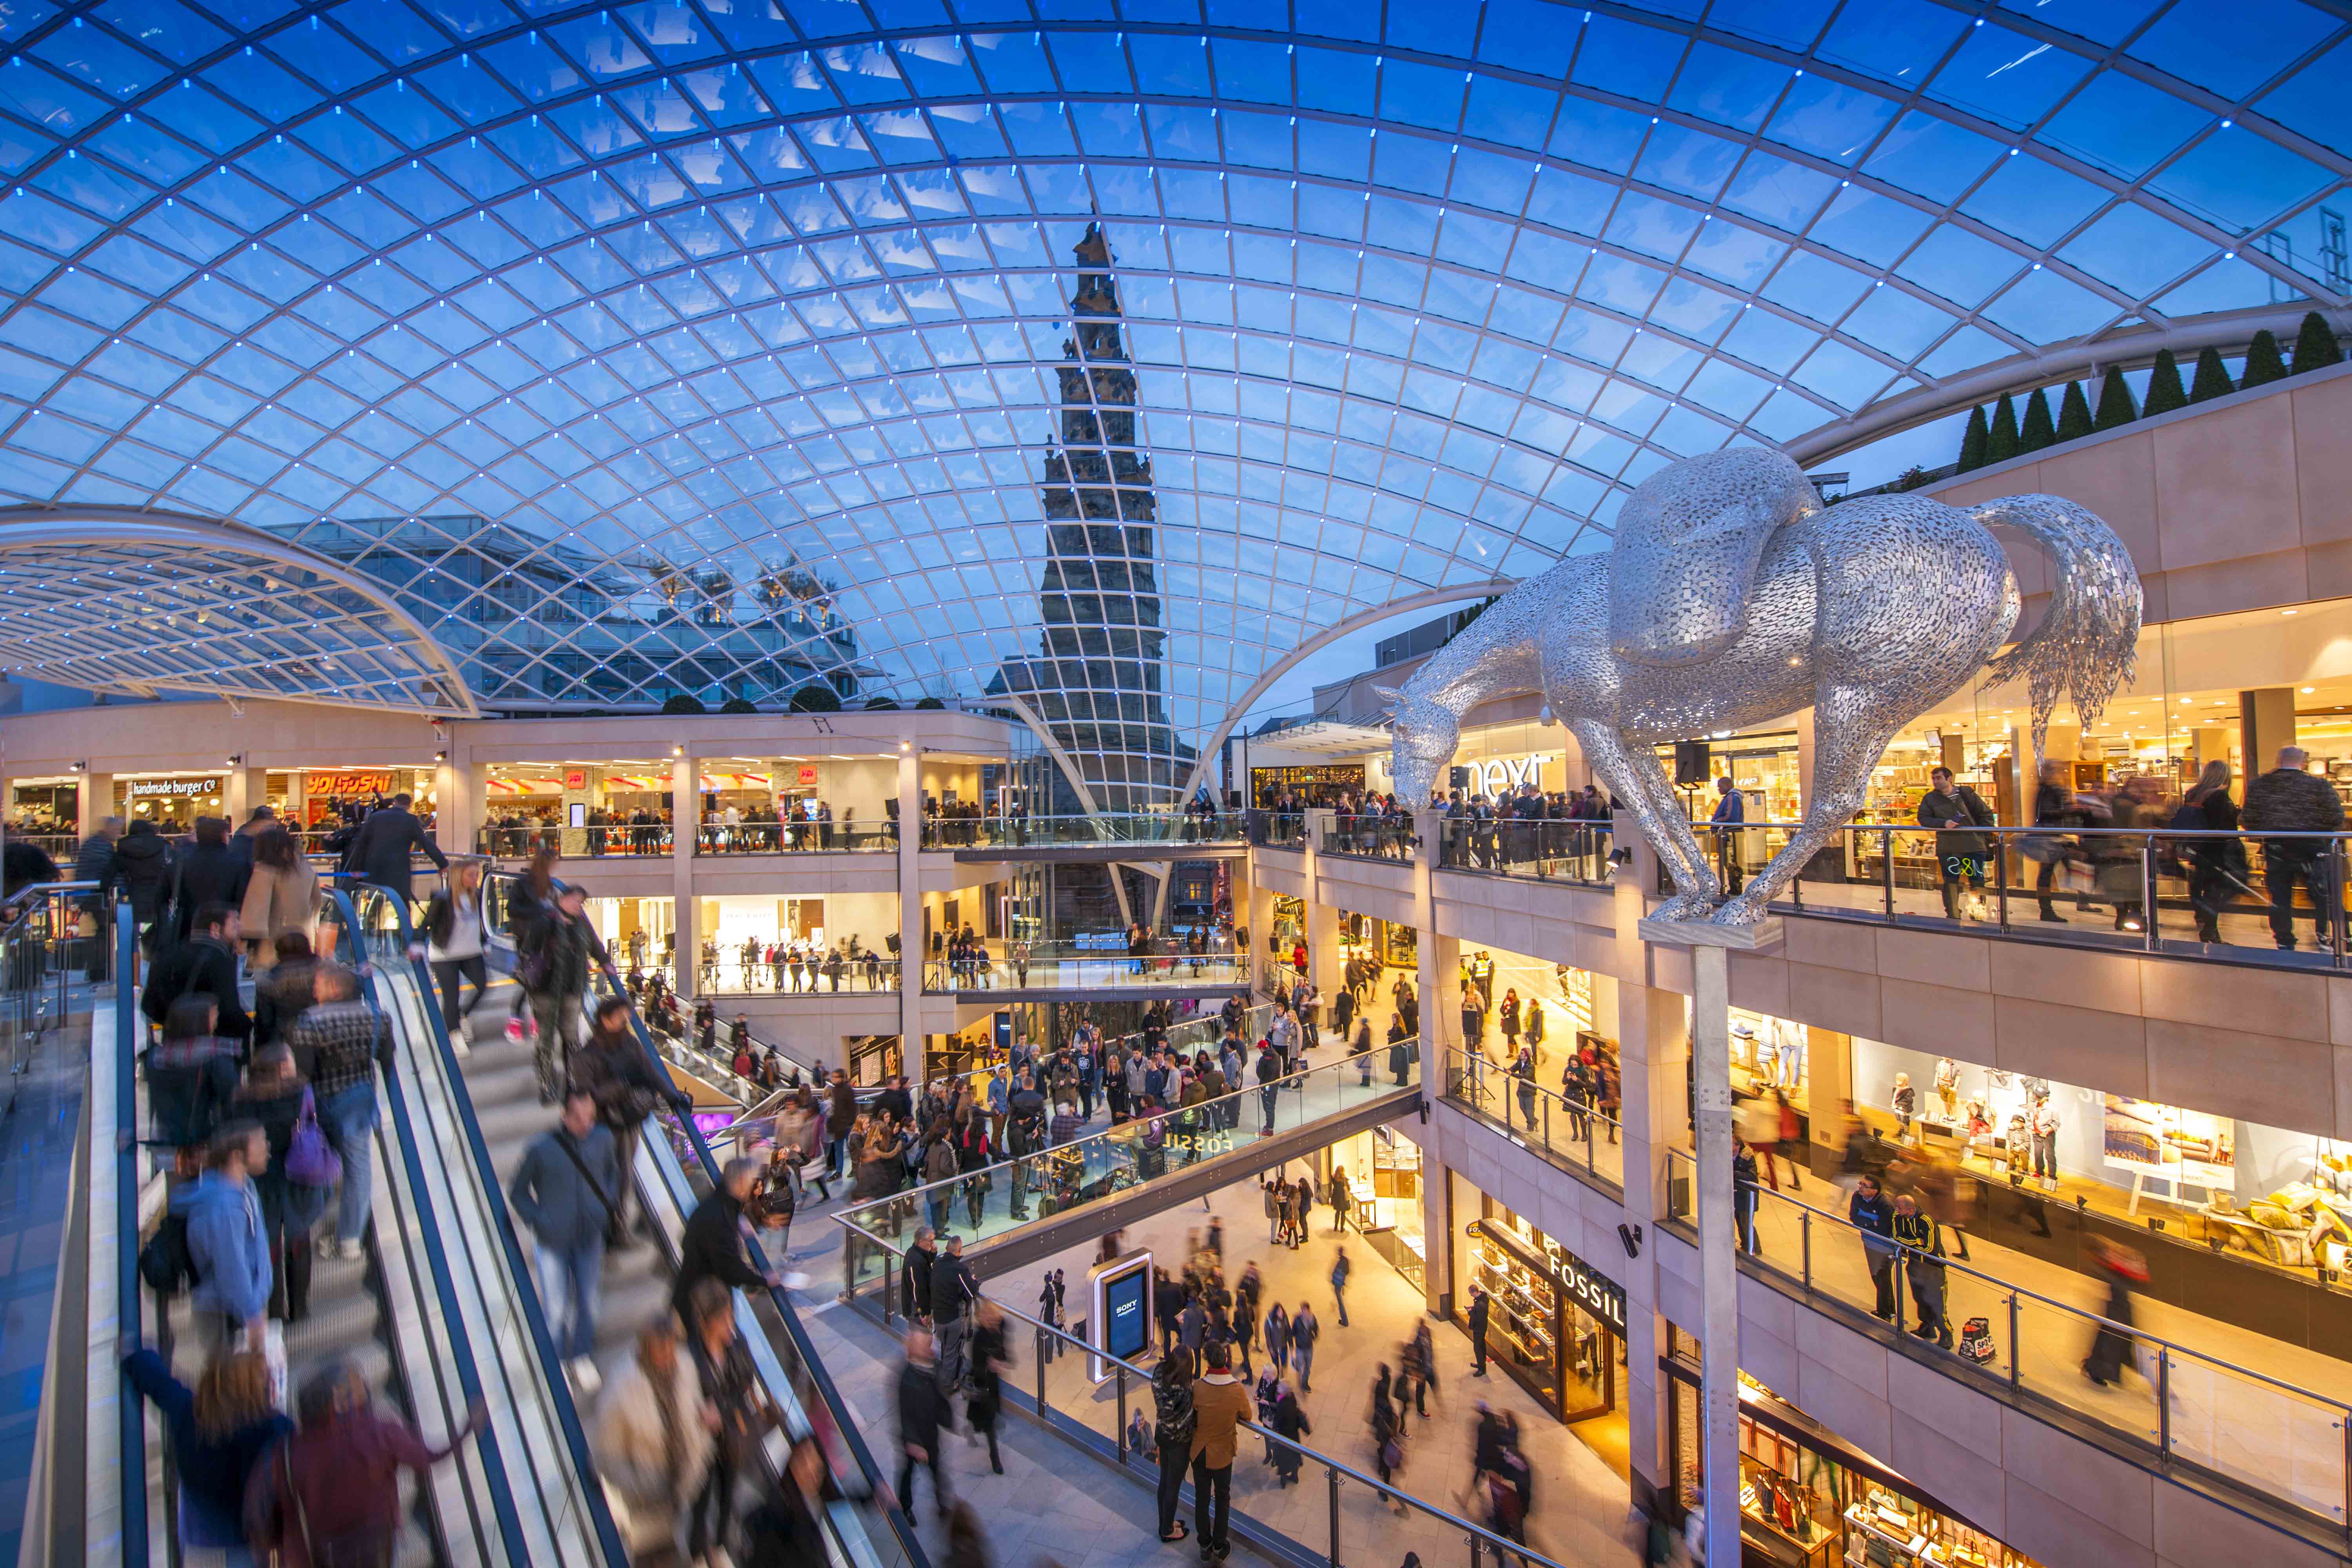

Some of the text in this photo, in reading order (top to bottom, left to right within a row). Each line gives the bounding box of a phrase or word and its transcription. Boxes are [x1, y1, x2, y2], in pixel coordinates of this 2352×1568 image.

[133, 780, 172, 795] handmade
[173, 780, 203, 796] burger
[1463, 753, 1553, 803] next
[1116, 1299, 1137, 1314] SONY
[1550, 1254, 1624, 1327] FOSSIL
